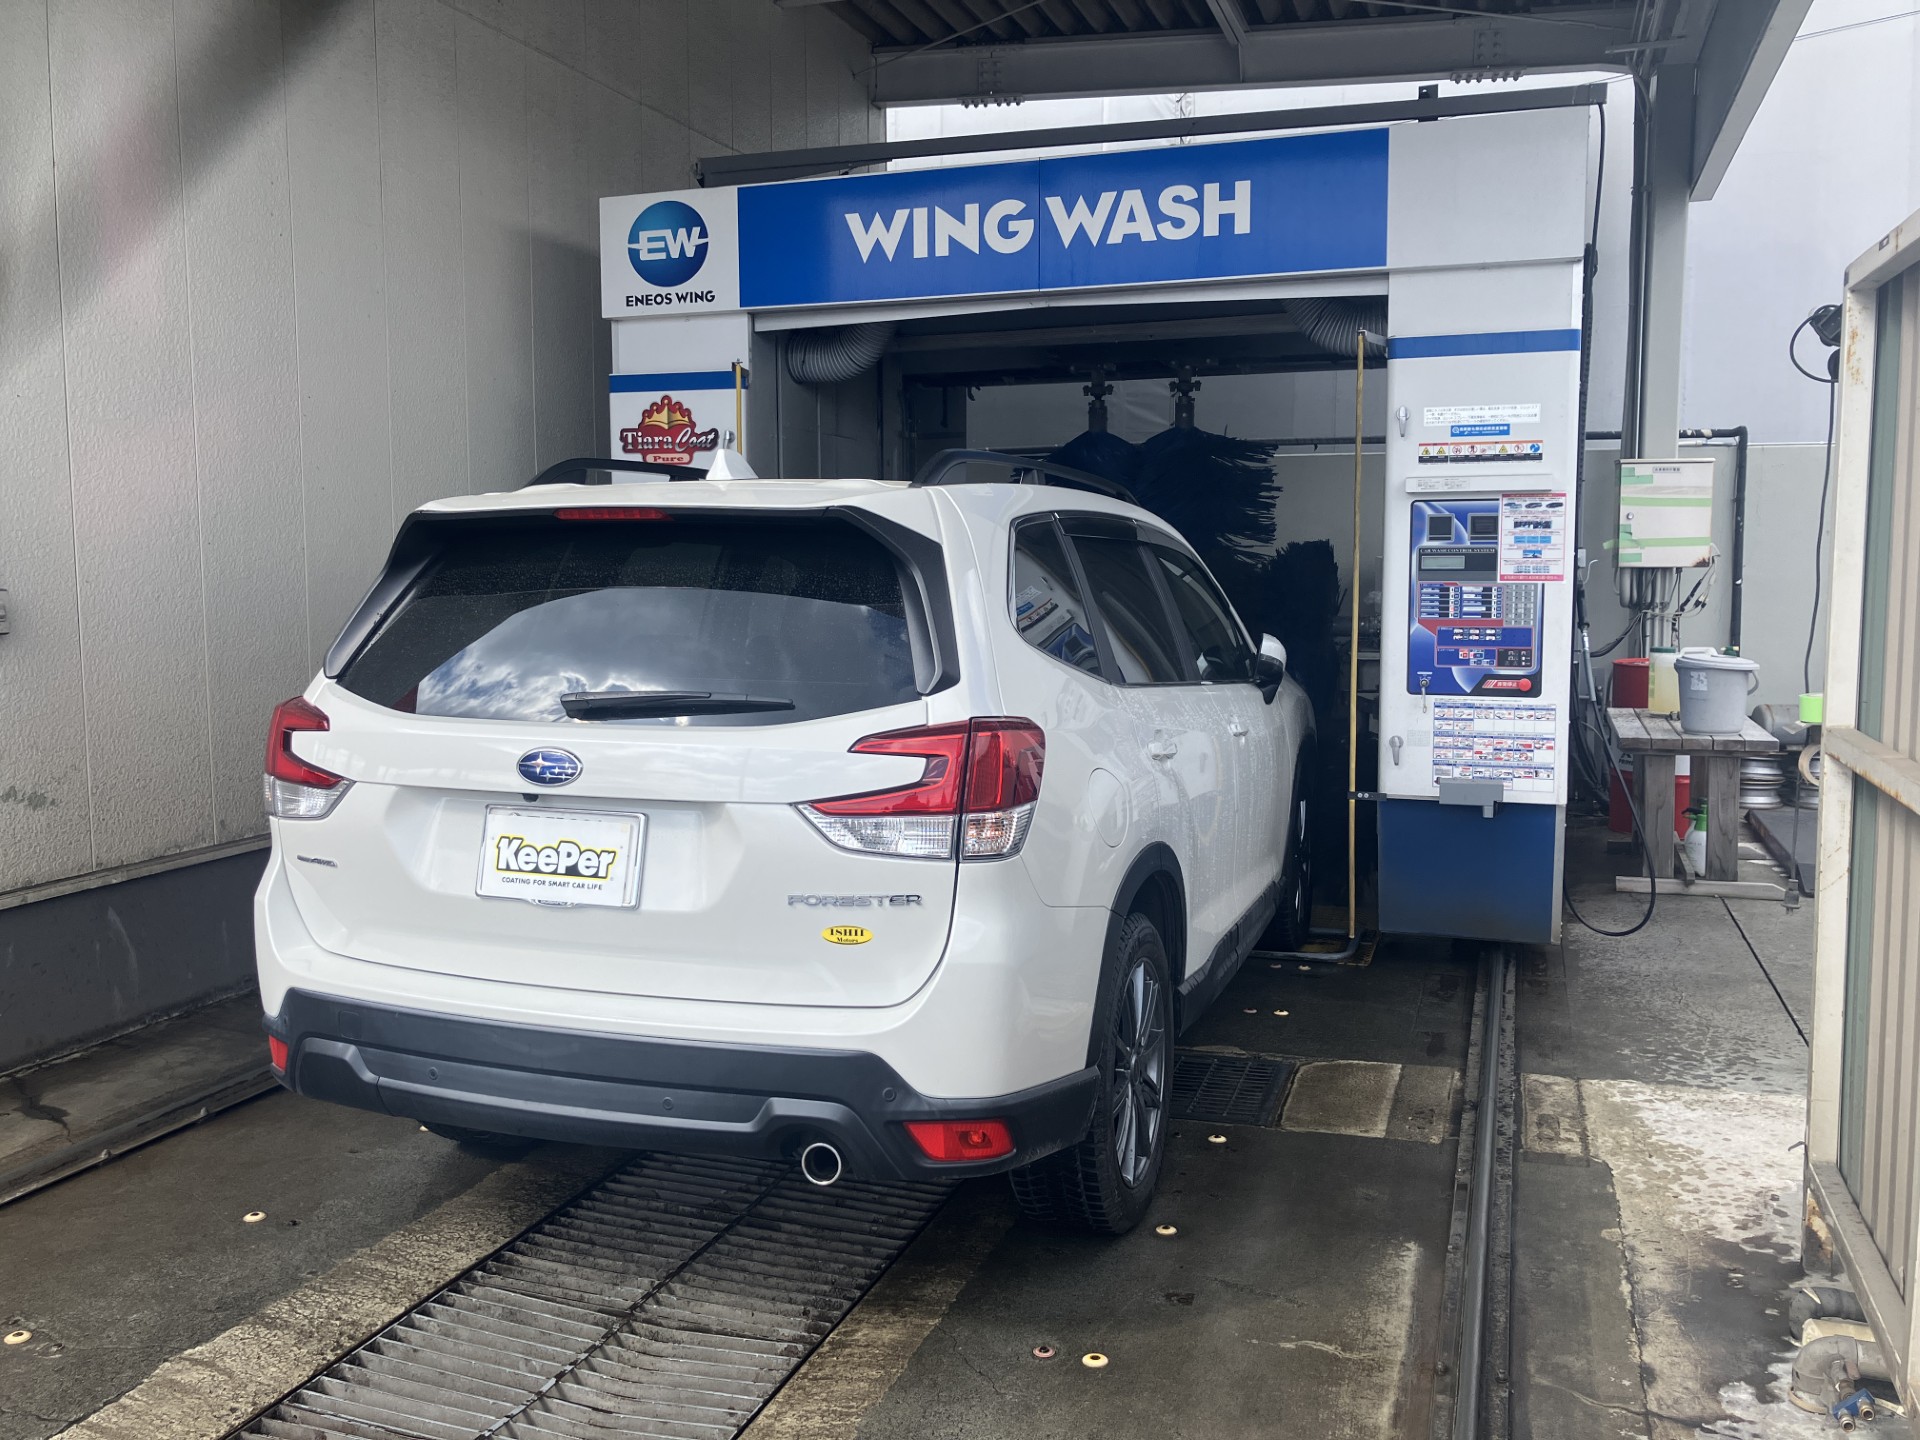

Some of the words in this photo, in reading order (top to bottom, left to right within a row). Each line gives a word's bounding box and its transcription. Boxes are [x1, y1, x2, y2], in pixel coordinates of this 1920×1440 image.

[845, 199, 1034, 264] WING
[1045, 180, 1251, 249] WASH
[638, 226, 702, 261] EW
[626, 292, 672, 307] ENEOS
[675, 290, 716, 304] WING
[623, 431, 673, 450] Tiara
[675, 427, 715, 452] Coat
[497, 836, 617, 879] KeePer
[502, 876, 531, 885] COATING
[532, 879, 547, 887] FOR
[548, 880, 570, 888] SMART
[587, 883, 603, 891] LIFE
[787, 894, 923, 907] FORESTER
[830, 928, 864, 937] ISHII
